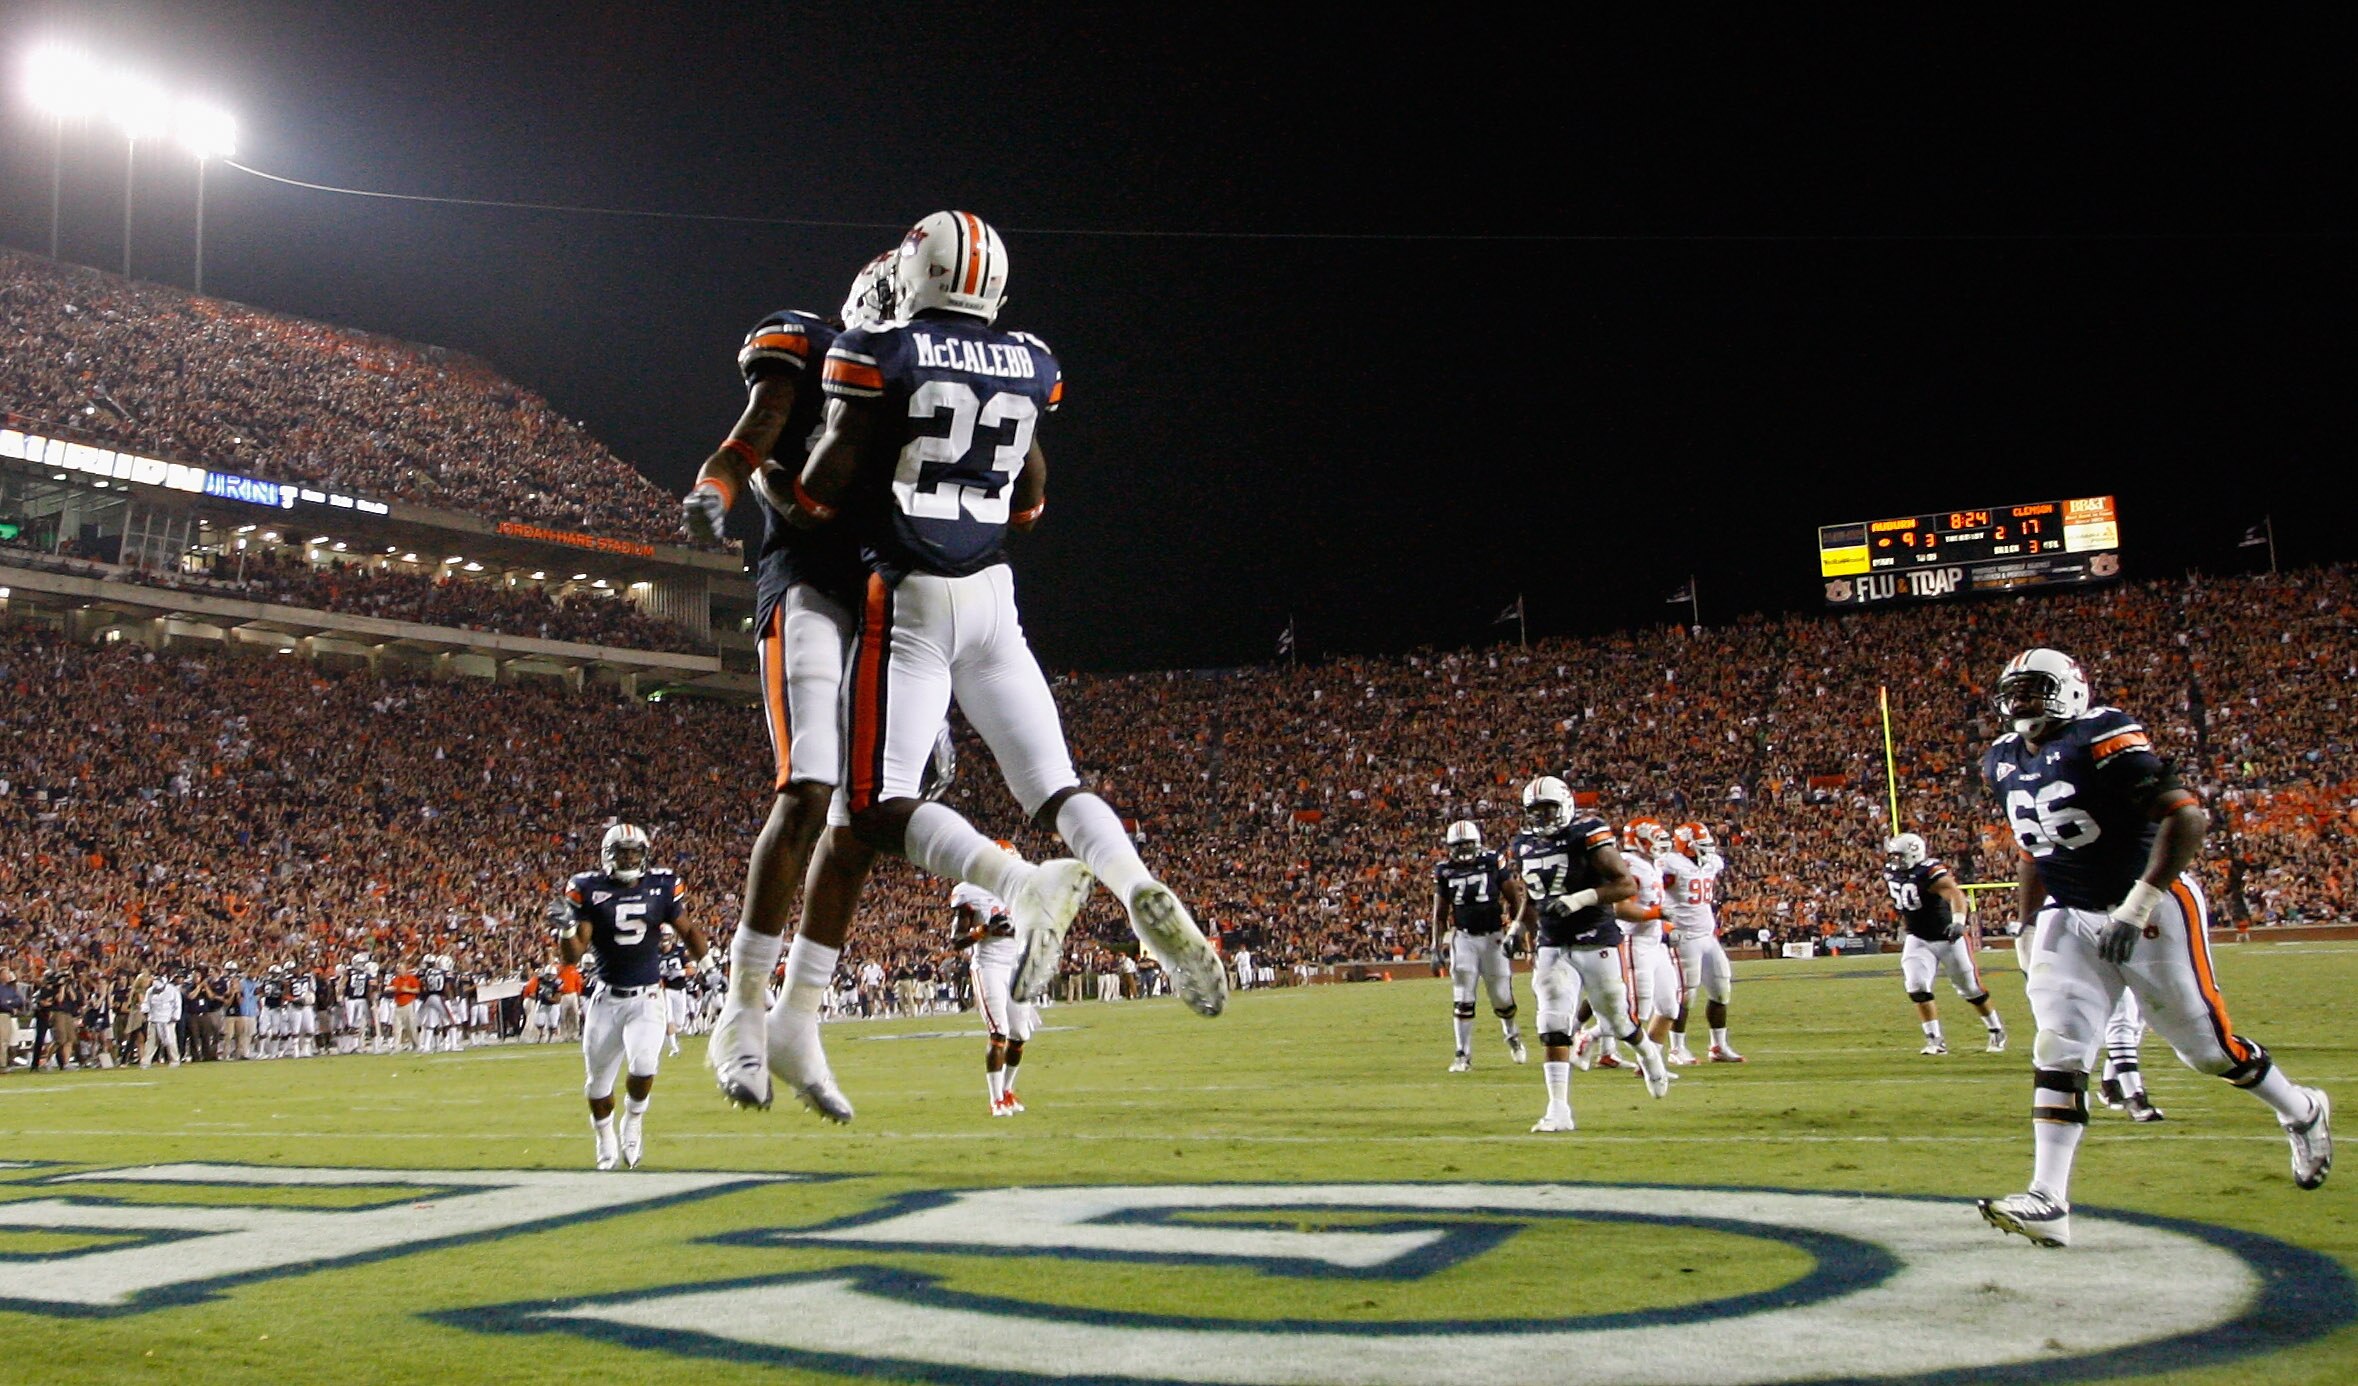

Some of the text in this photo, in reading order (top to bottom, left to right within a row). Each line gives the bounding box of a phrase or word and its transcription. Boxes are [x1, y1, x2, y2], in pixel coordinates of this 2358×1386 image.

[912, 333, 1035, 379] McCALEBB
[892, 380, 1039, 525] 23
[1950, 511, 1987, 529] 8:24
[1995, 526, 2006, 540] 2
[2022, 519, 2040, 535] 17
[496, 520, 657, 557] JORDAN-HARE STADIUM
[1902, 532, 1915, 547] 9
[1925, 533, 1936, 548] 3
[2029, 540, 2039, 554] 3
[1856, 573, 1896, 603] FLU
[1906, 567, 1963, 596] TDAP
[2006, 780, 2101, 859] 66
[1448, 872, 1490, 906] 77
[1521, 853, 1569, 901] 57
[1687, 878, 1714, 905] 98
[1888, 880, 1923, 911] 50
[613, 902, 648, 946] 5
